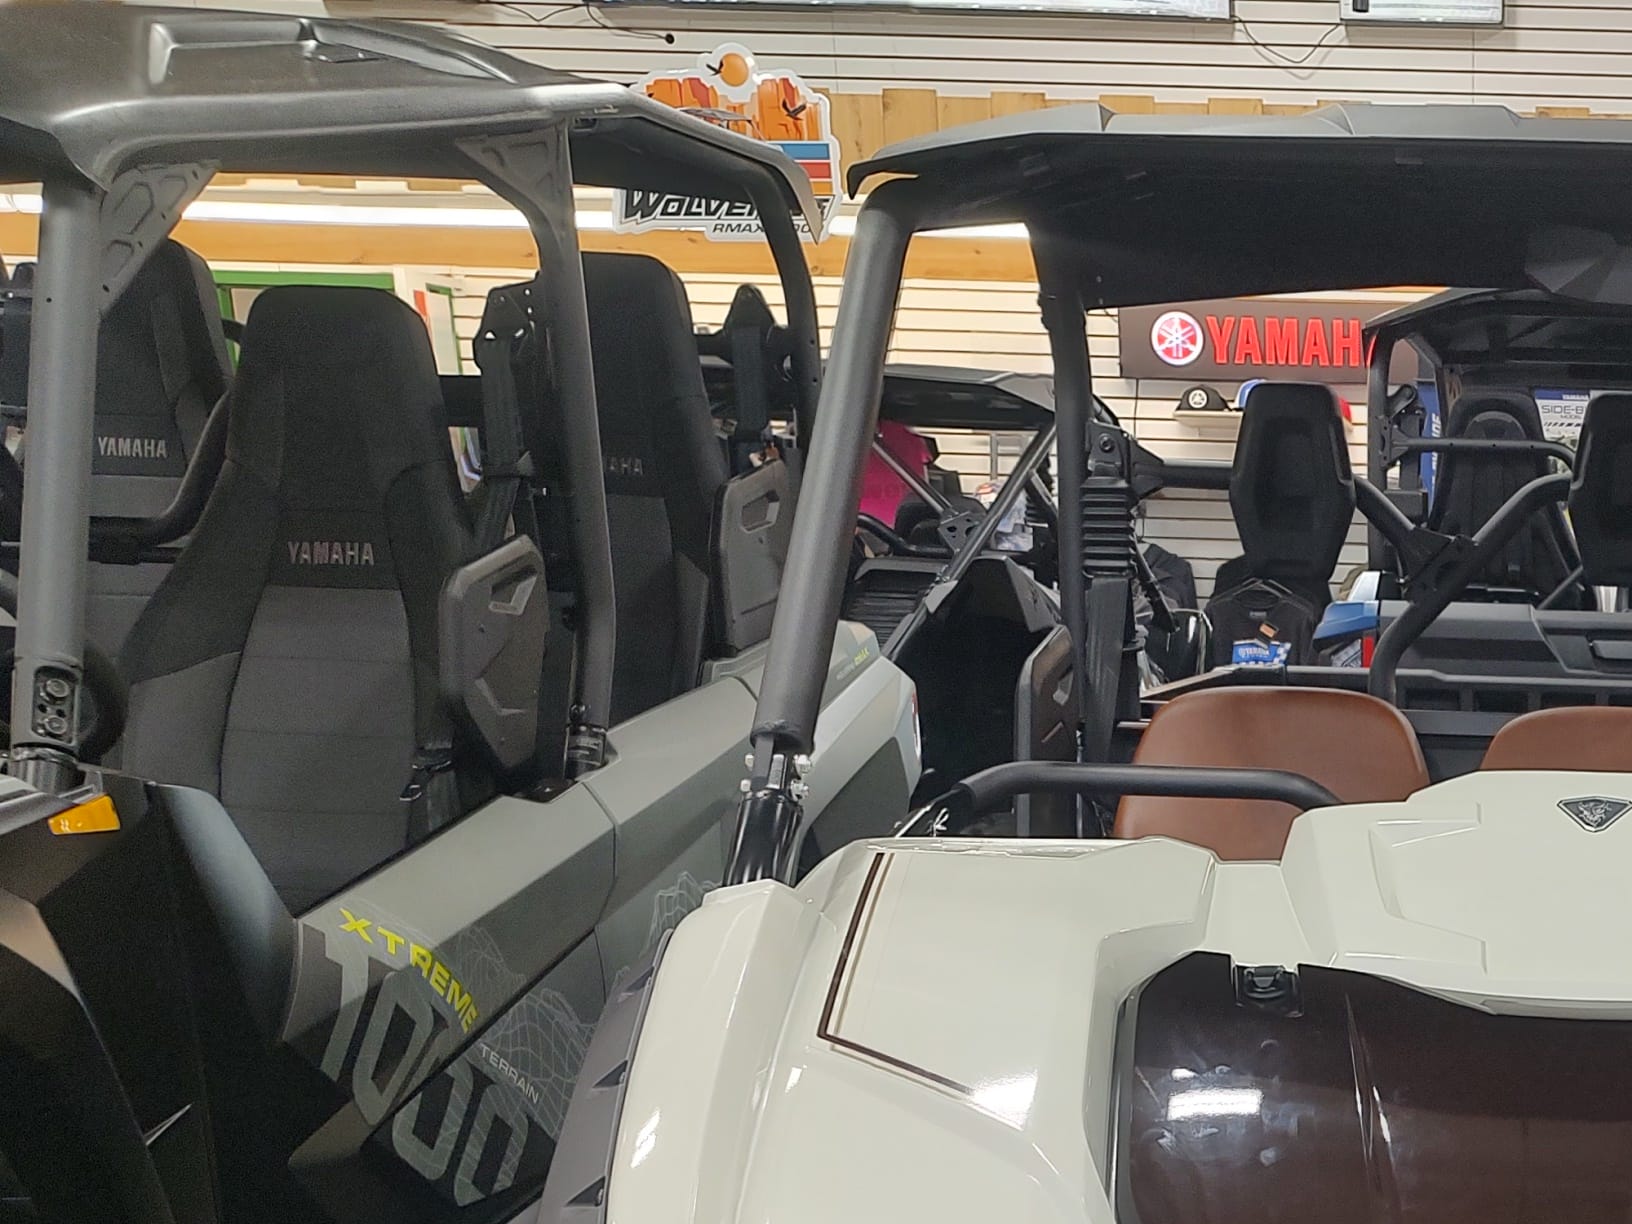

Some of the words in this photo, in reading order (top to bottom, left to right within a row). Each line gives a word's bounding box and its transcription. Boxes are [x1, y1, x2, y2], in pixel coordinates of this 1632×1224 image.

[1205, 315, 1376, 367] YAMAH
[1541, 404, 1585, 415] SIDE-B
[98, 436, 168, 458] YAMAHA
[602, 456, 643, 475] AHA
[288, 541, 375, 566] YAMAHA
[339, 908, 480, 1033] XTREME
[320, 928, 530, 1206] 1000
[479, 1043, 540, 1103] TERRAIN
